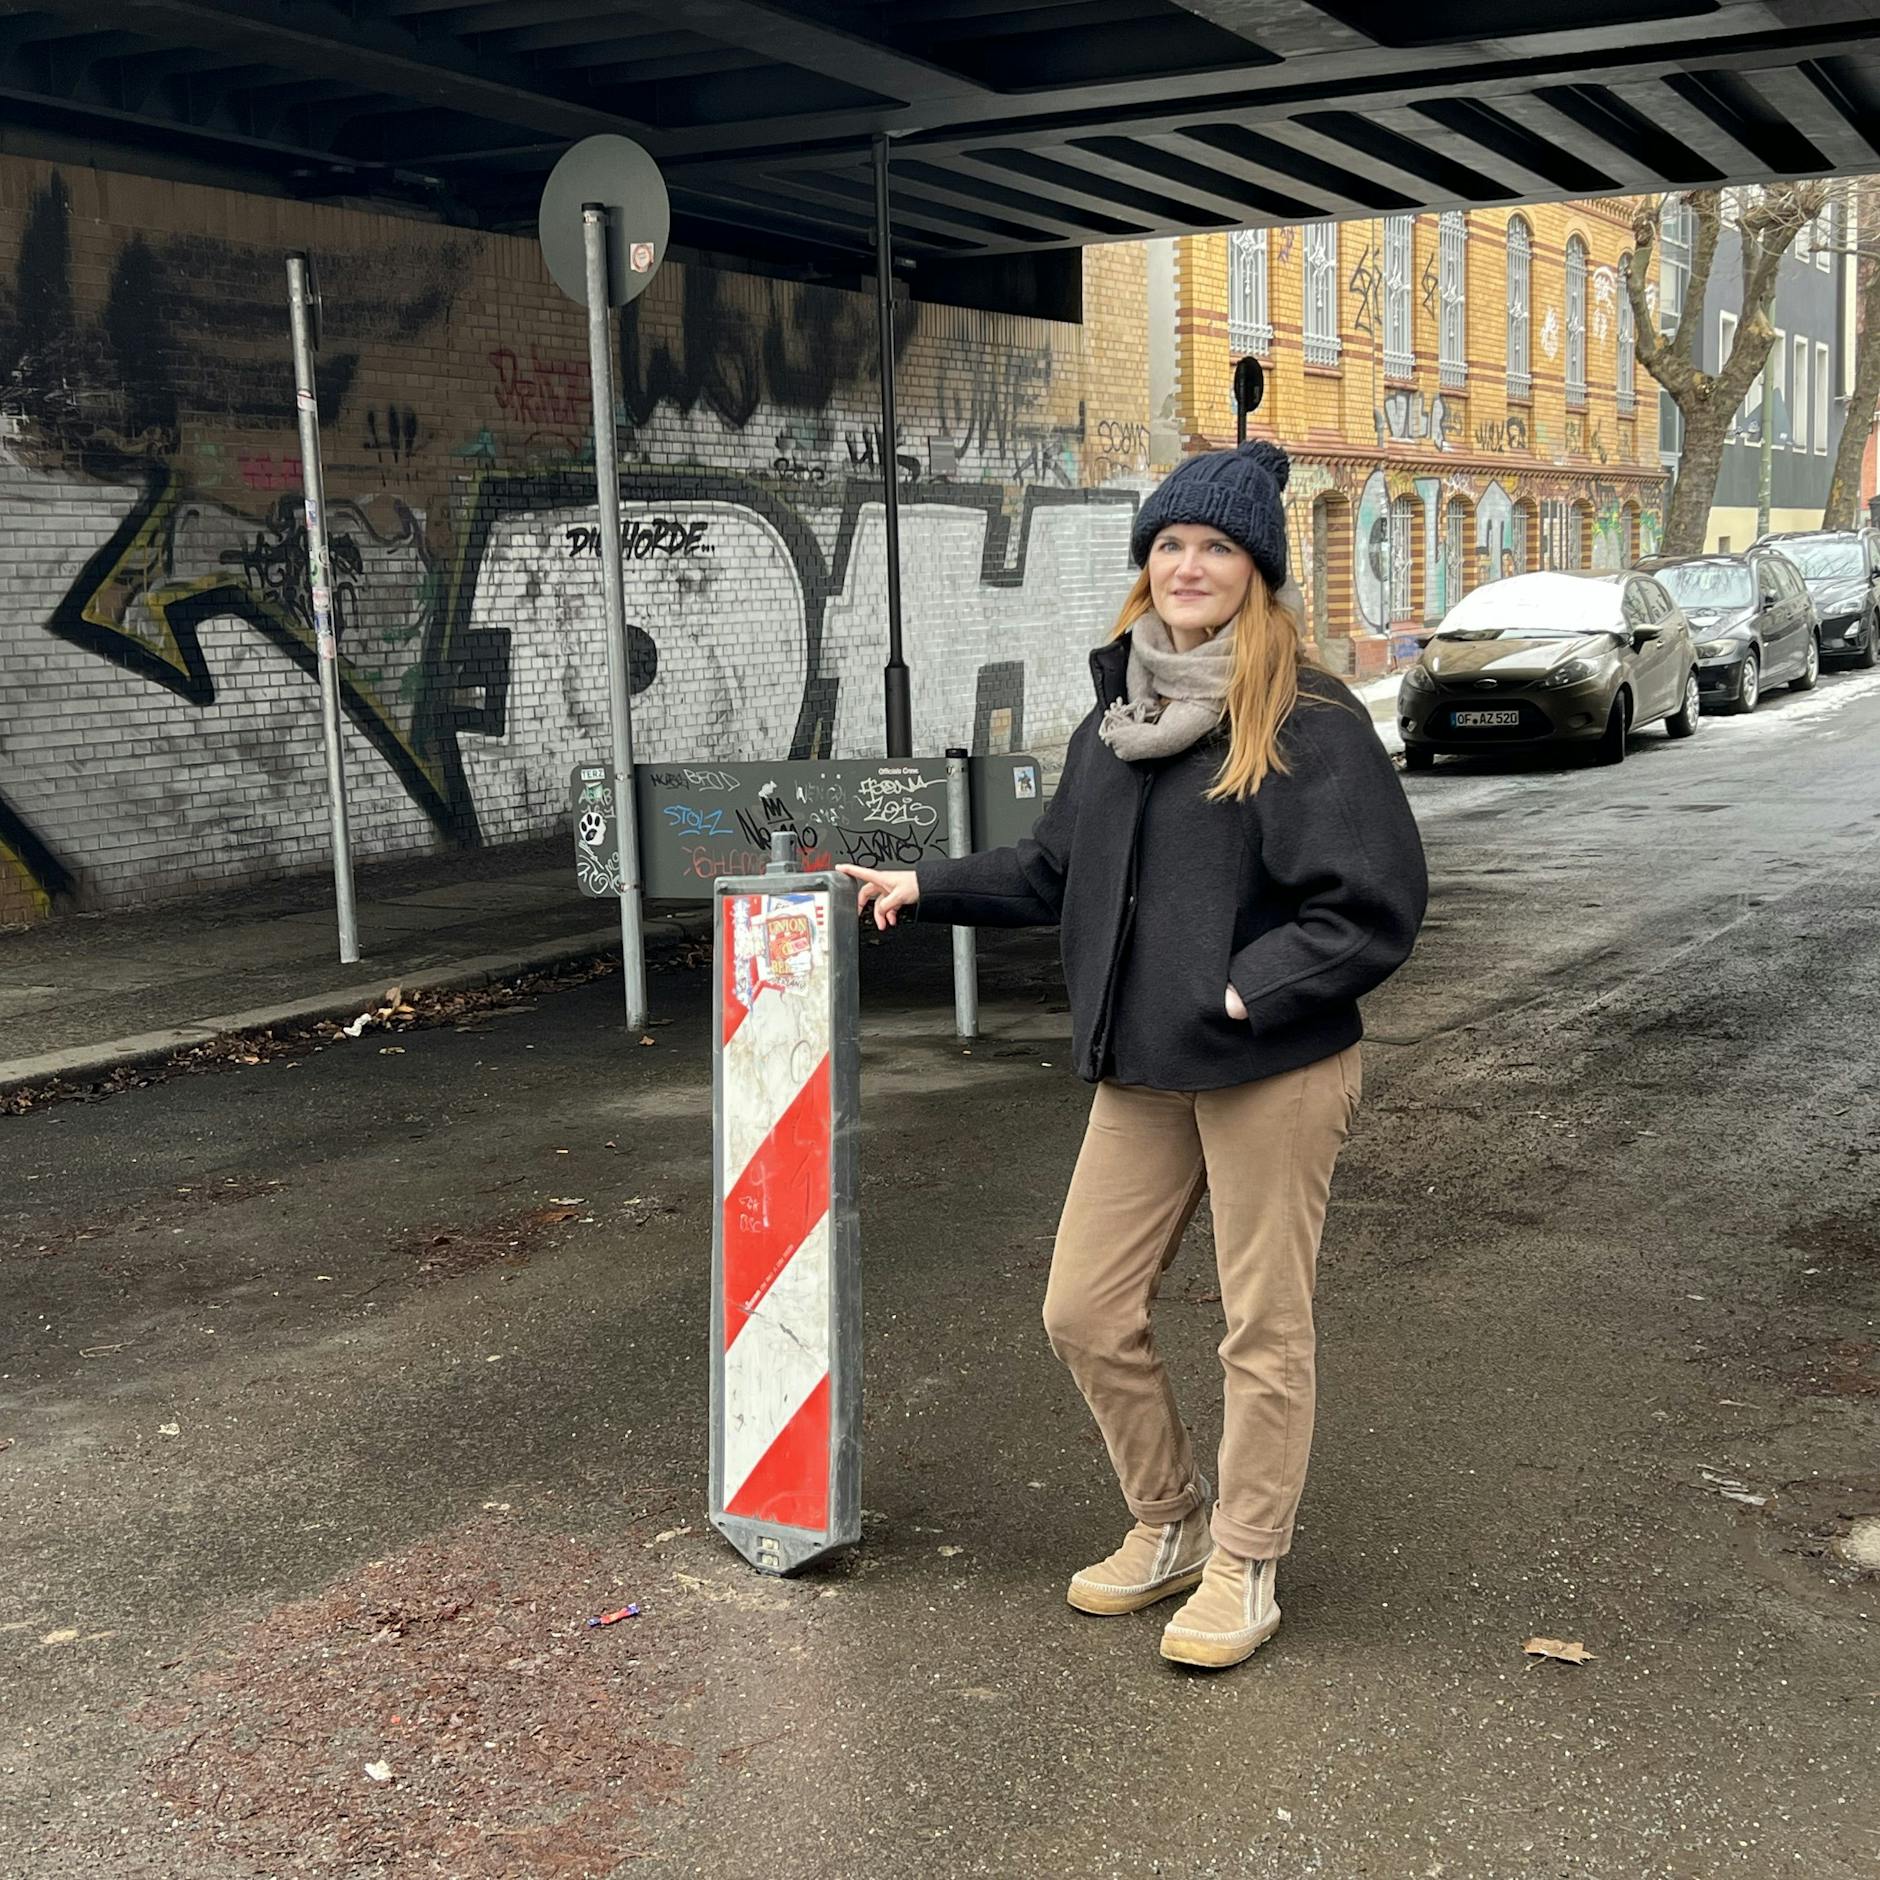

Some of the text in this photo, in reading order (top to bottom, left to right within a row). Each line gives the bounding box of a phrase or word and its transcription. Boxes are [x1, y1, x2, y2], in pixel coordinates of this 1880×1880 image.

[1457, 712, 1518, 725] OF AZ 520
[767, 917, 808, 934] UNION
